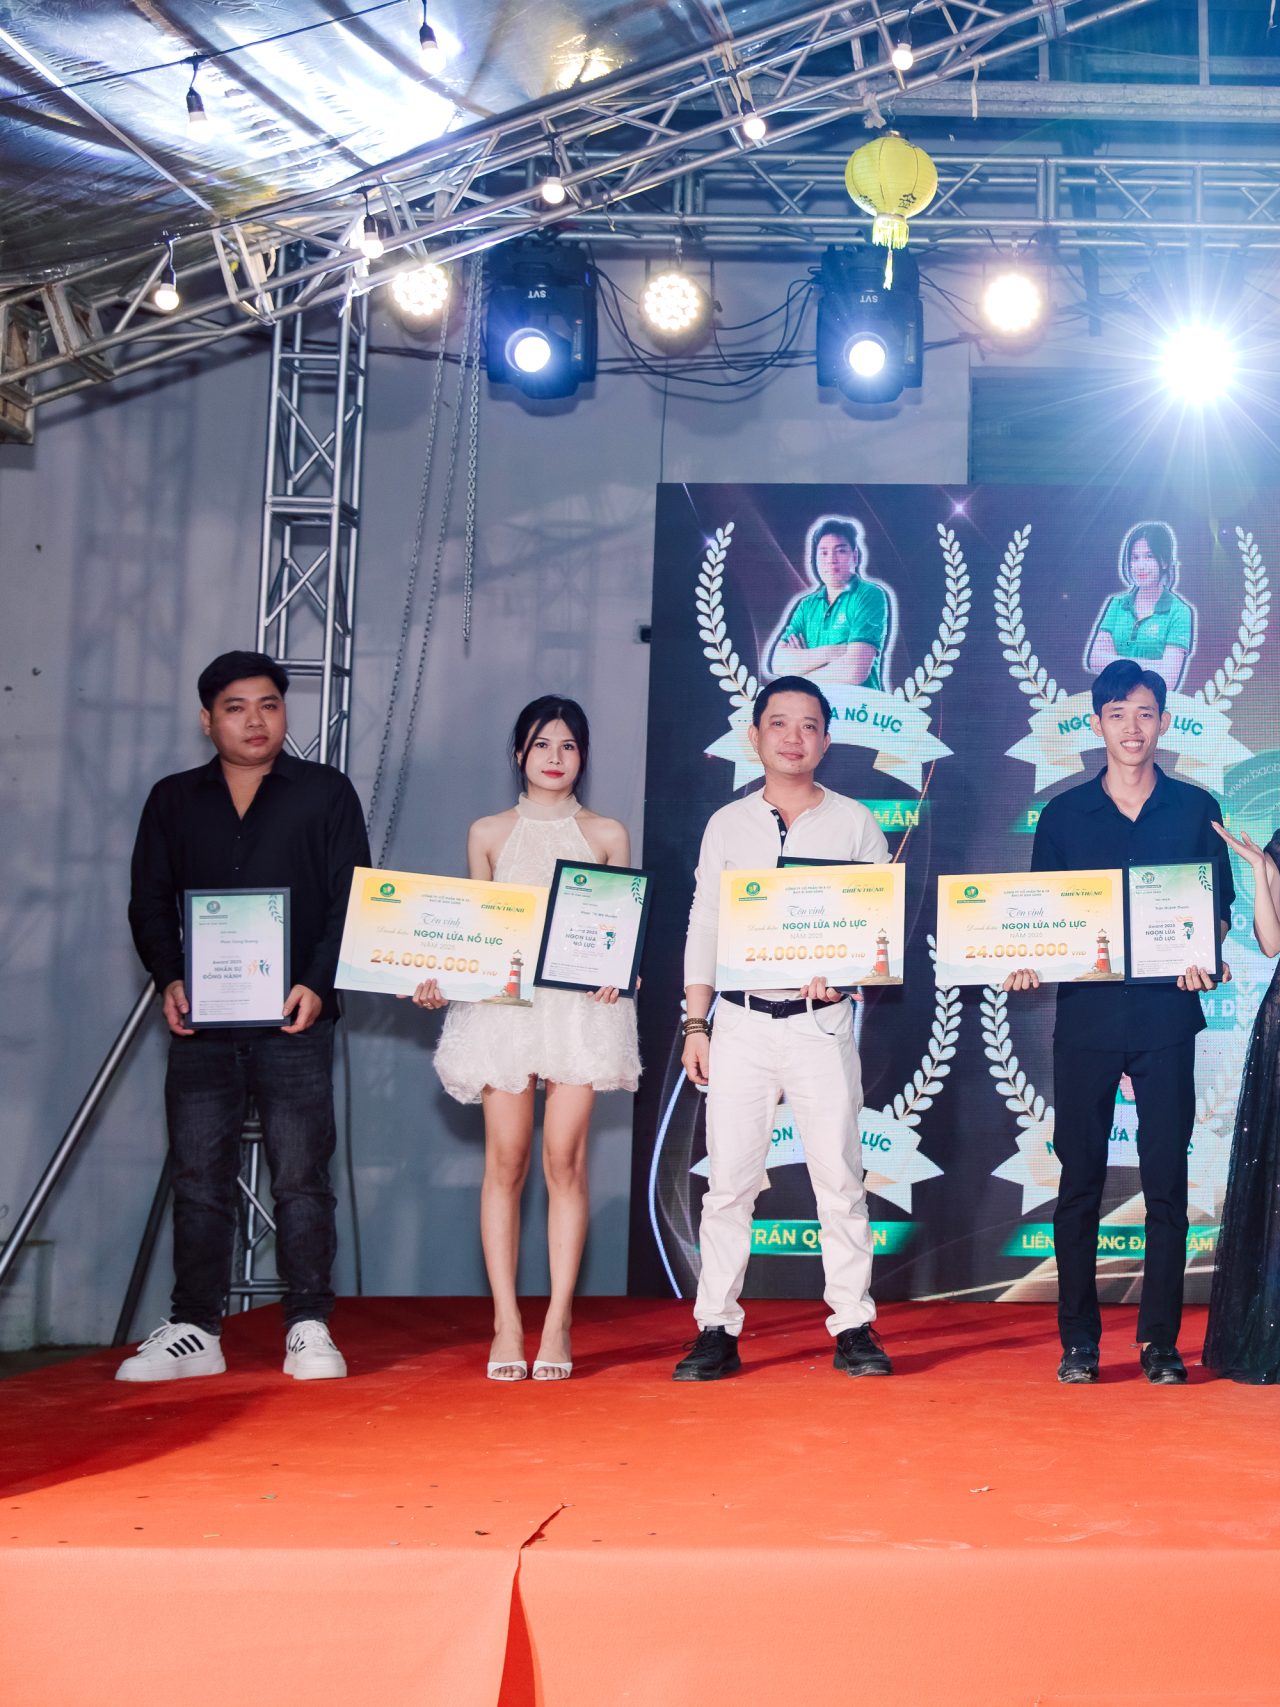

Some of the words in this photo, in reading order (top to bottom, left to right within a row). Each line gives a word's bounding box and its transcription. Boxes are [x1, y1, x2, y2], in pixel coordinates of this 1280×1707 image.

[873, 712, 903, 733] LỰC
[1173, 715, 1203, 736] LỰC
[413, 929, 444, 941] NGỌN
[782, 922, 810, 932] NGỌN
[1002, 922, 1030, 932] NGỌN
[745, 943, 848, 962] 24.000.000
[965, 942, 1068, 959] 24.000.000
[370, 949, 479, 974] 24.000.000
[861, 1131, 892, 1152] LỰC
